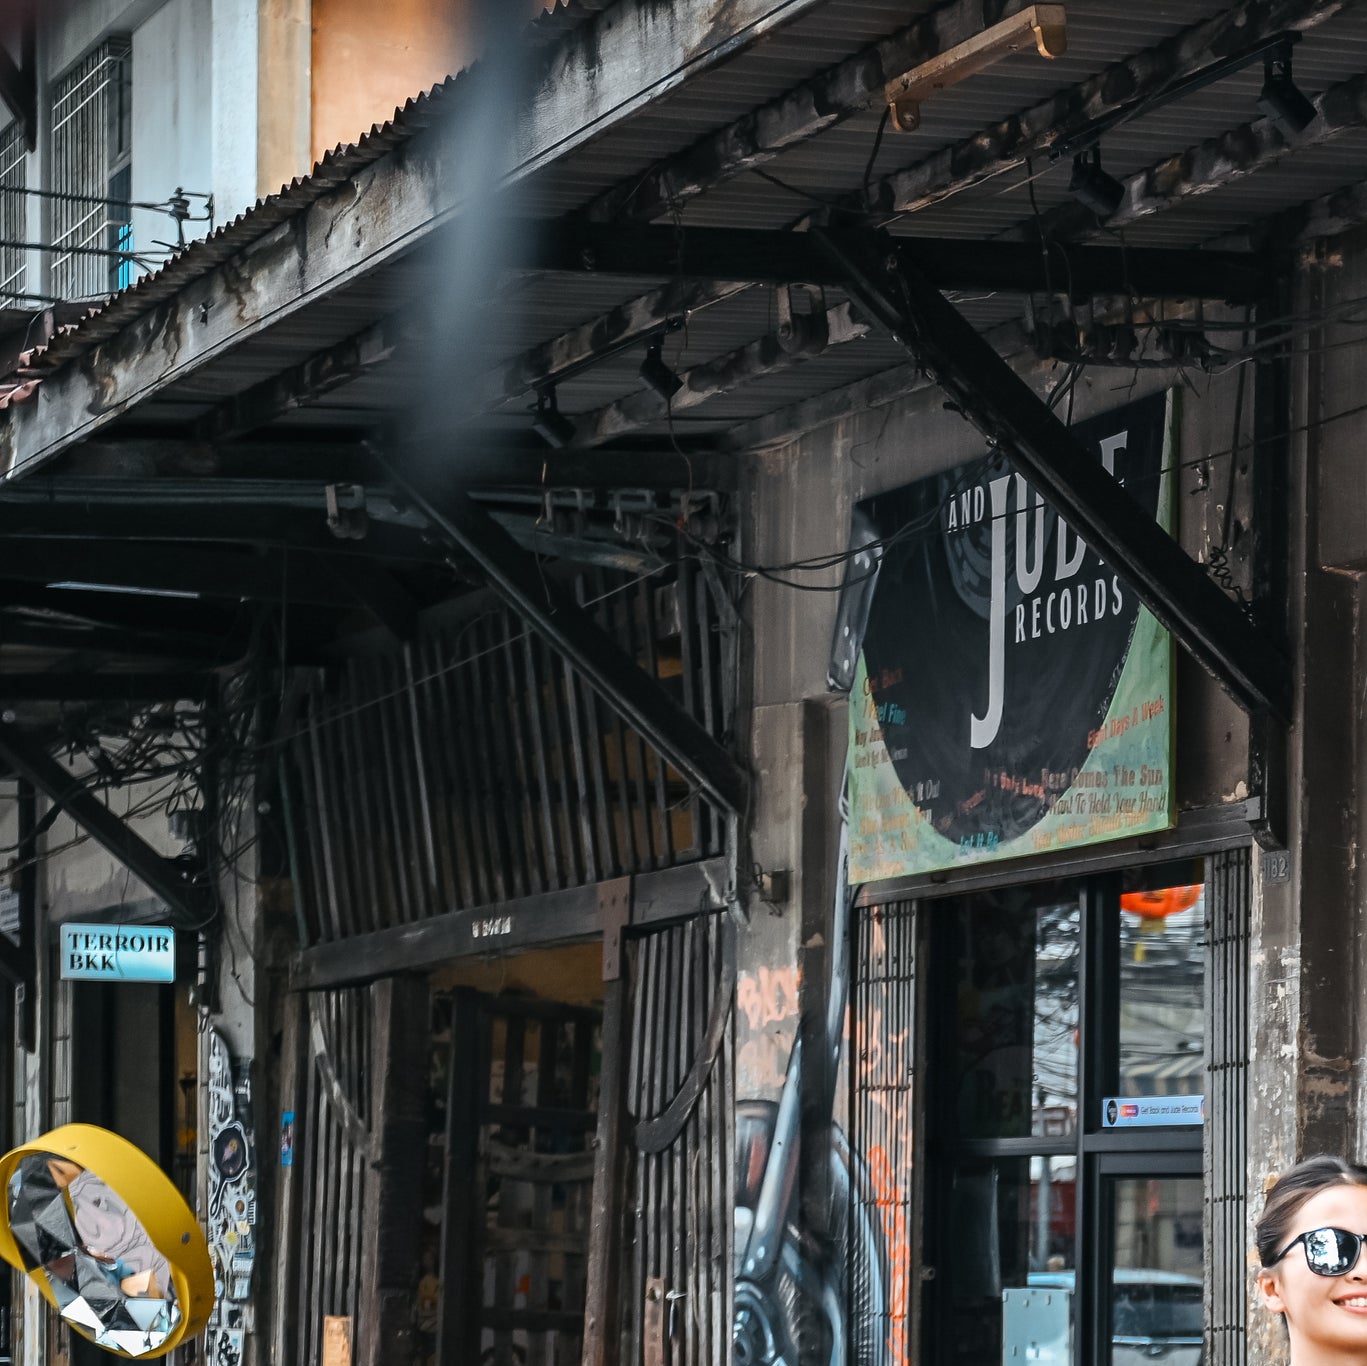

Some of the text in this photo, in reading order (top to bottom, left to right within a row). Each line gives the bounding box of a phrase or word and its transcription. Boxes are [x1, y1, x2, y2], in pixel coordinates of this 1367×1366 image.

[948, 486, 985, 533] AND
[1015, 575, 1123, 643] RECORDS
[1141, 694, 1164, 723] Week
[1071, 766, 1109, 788] Comes
[1114, 764, 1135, 786] The
[1140, 763, 1163, 786] Sun
[1088, 793, 1111, 815] Hold
[1139, 790, 1167, 812] Hand
[68, 932, 170, 953] TERROIR
[69, 953, 116, 971] BKK
